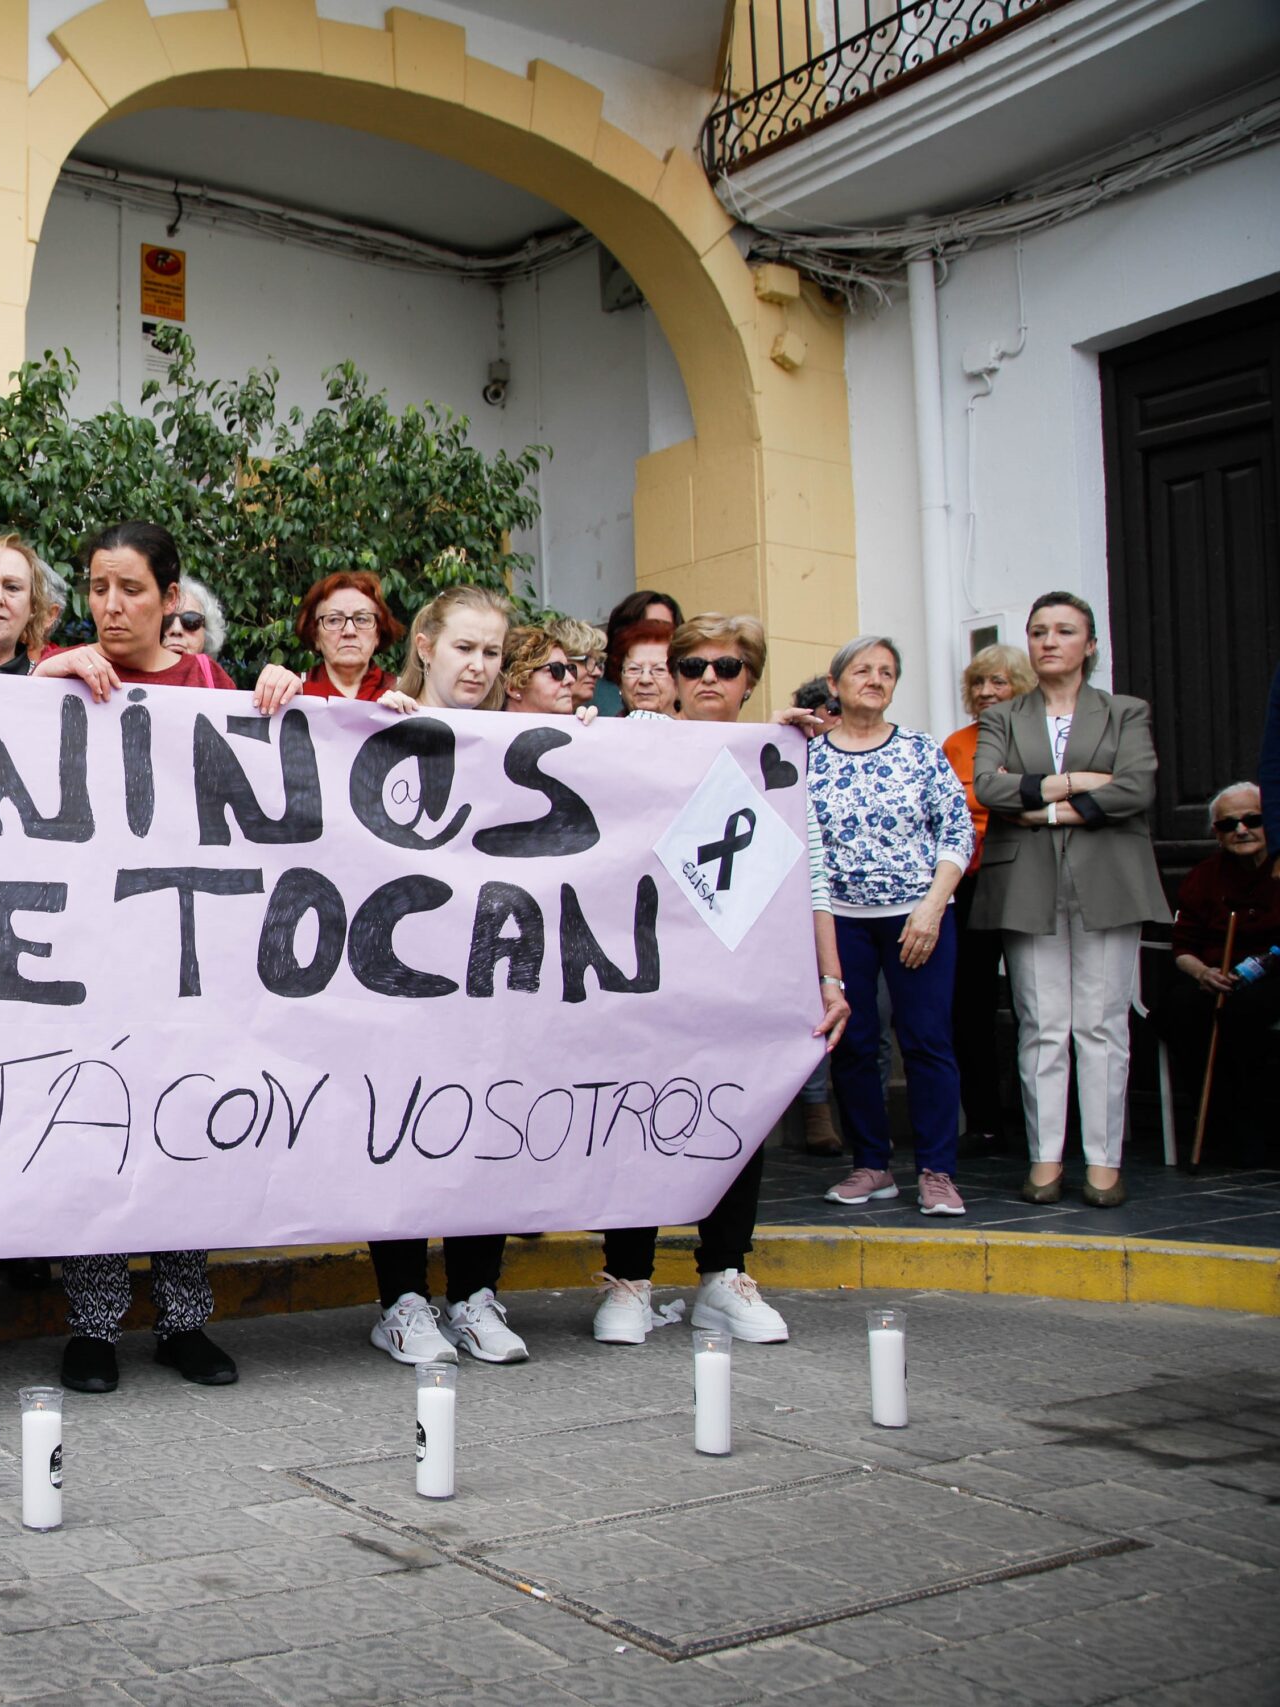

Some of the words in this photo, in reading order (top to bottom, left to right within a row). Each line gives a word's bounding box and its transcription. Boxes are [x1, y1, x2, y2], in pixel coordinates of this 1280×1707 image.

[114, 867, 660, 1003] TOCAN
[153, 1070, 329, 1162] CON
[364, 1074, 745, 1165] VOSOTR@S
